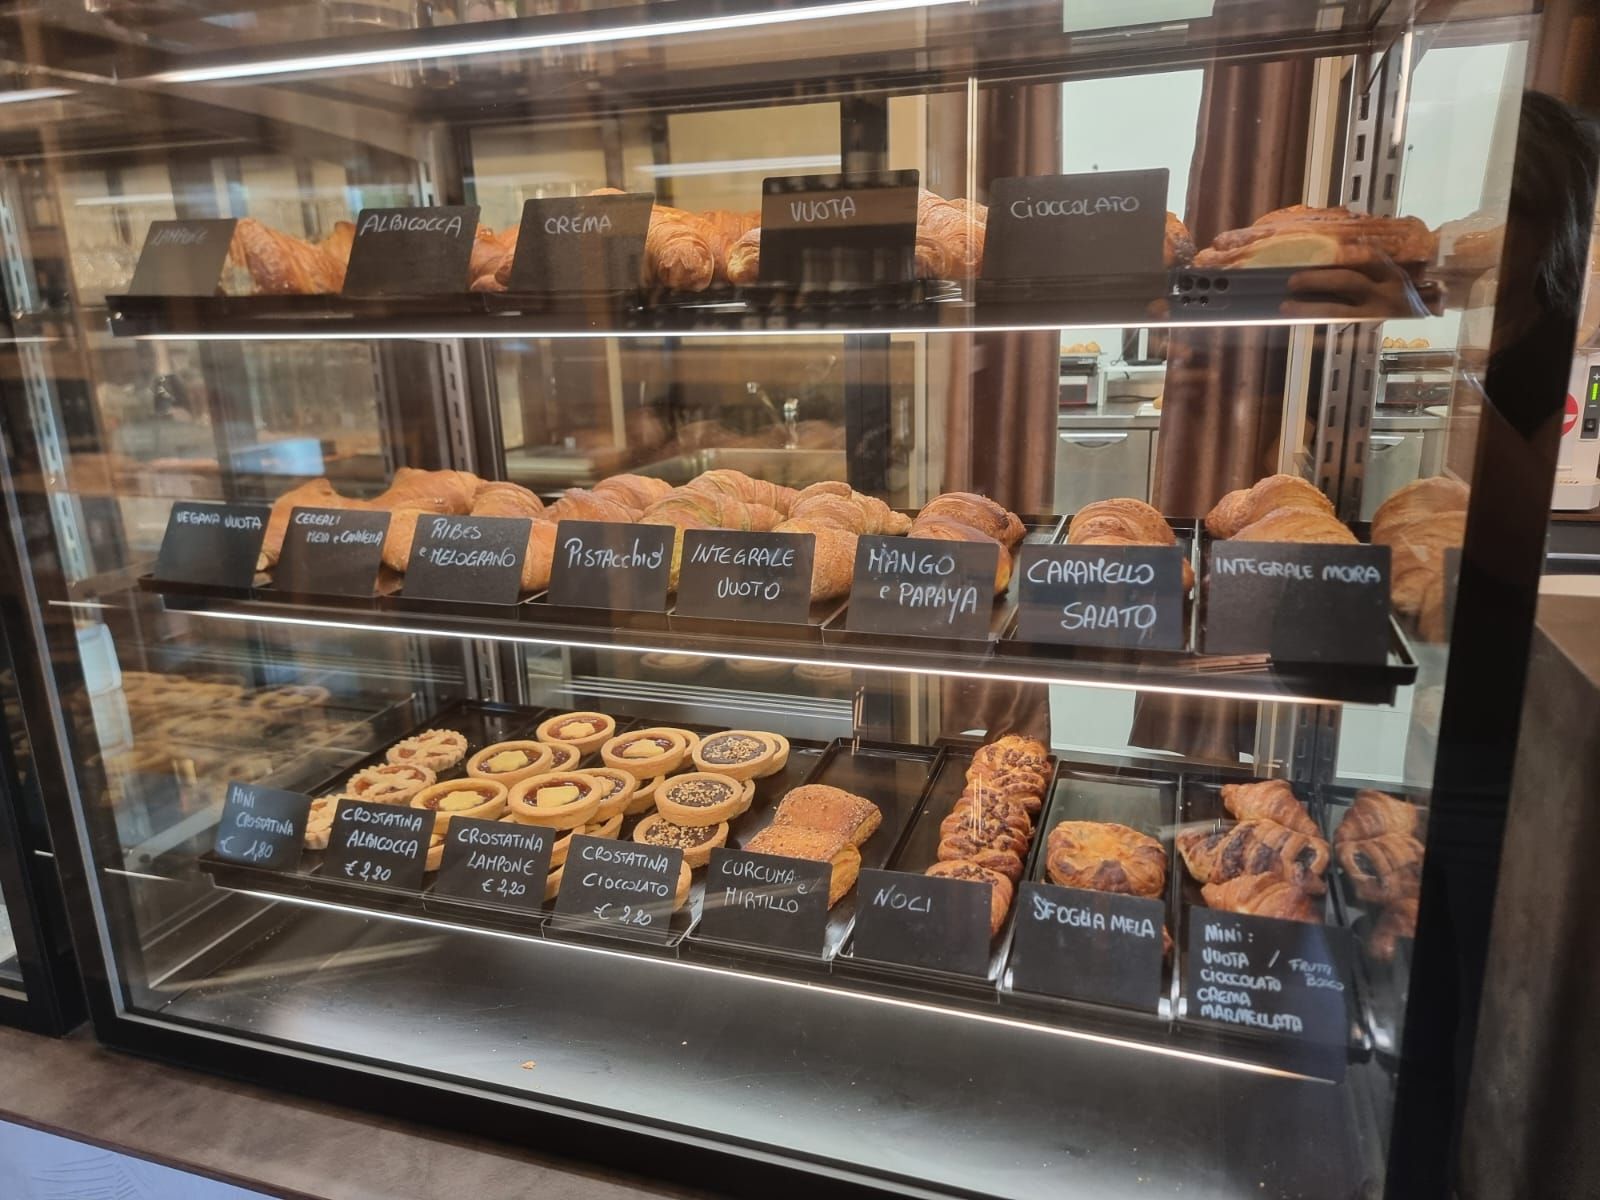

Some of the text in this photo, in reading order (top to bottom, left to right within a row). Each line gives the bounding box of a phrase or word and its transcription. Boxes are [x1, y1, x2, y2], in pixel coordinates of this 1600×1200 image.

[790, 196, 856, 222] VUOTA
[359, 213, 464, 238] ALBICOCCA
[544, 214, 613, 236] CREMA
[176, 511, 264, 531] VEGANA VUOTA
[294, 512, 341, 526] CEREALI
[428, 547, 517, 569] MELOGRANO
[690, 543, 796, 568] INTEGRALE
[867, 543, 956, 576] MANGO
[1026, 557, 1156, 585] CARAMELLO
[1215, 556, 1382, 584] INTEGRALE MORA
[717, 576, 781, 600] VUOTO
[899, 582, 979, 625] PAPAYA
[1060, 601, 1158, 631] SALATO
[231, 786, 255, 809] MINI
[235, 811, 294, 837] CROSTATINA
[341, 806, 424, 833] CROSTATINA
[242, 841, 273, 863] 1,80
[346, 829, 419, 860] ALBICOCCA
[457, 827, 544, 853] CROSTATINA
[466, 851, 536, 876] LAMPONE
[581, 845, 670, 874] CROSTATINA
[721, 858, 796, 885] CURCUMA
[582, 872, 669, 897] CIOCCOLATO
[723, 886, 799, 913] MIRTILLO
[871, 883, 932, 914] NOCI
[1110, 914, 1156, 939] MELA
[1201, 946, 1250, 970] VUOTA
[1196, 986, 1252, 1007] CREMA
[1199, 1003, 1303, 1033] MARMELLATA
